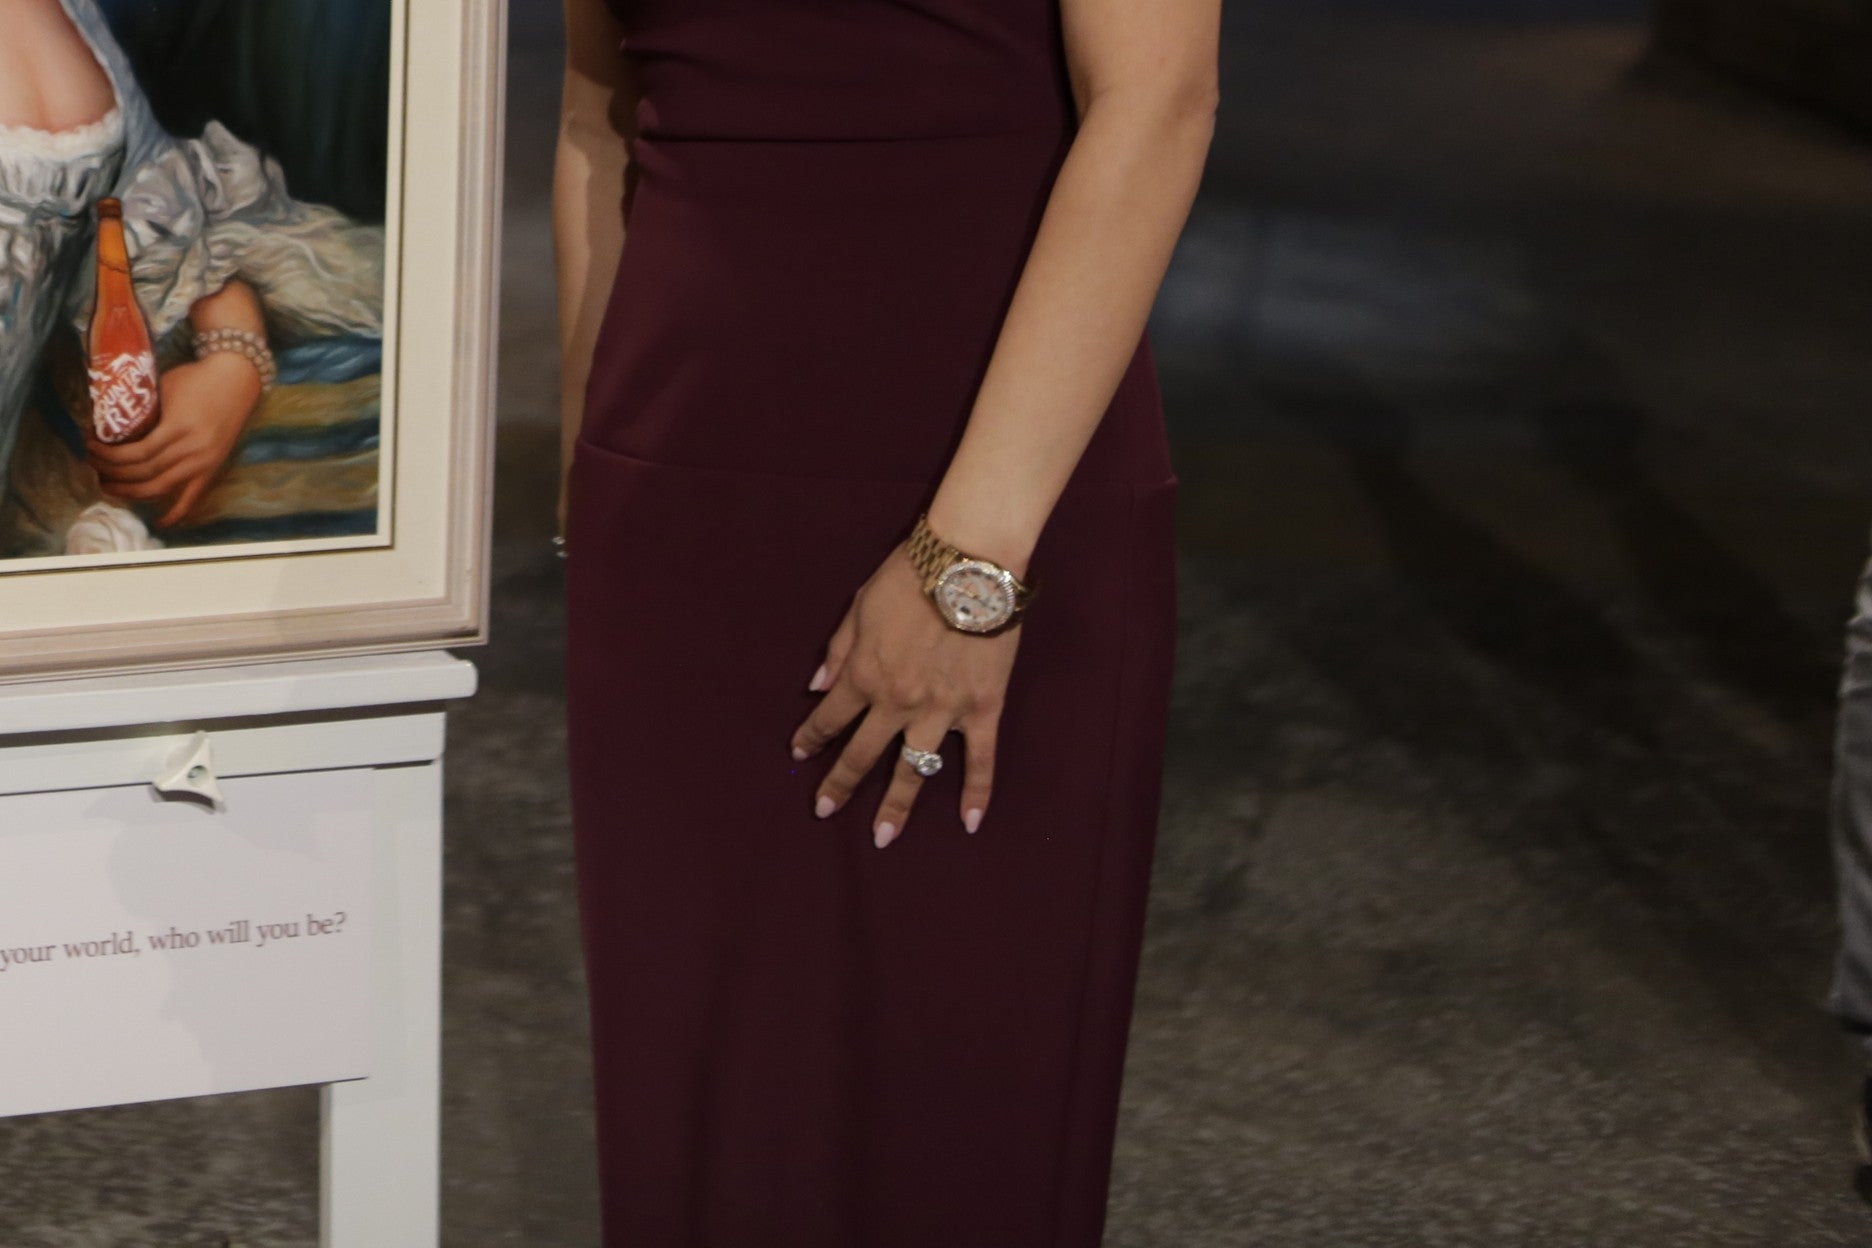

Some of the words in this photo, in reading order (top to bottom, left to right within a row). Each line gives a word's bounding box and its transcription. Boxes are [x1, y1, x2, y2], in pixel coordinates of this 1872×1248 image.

[63, 930, 140, 959] world,
[148, 927, 200, 951] who
[206, 919, 250, 945] will
[255, 919, 300, 948] you
[306, 911, 347, 937] be?
